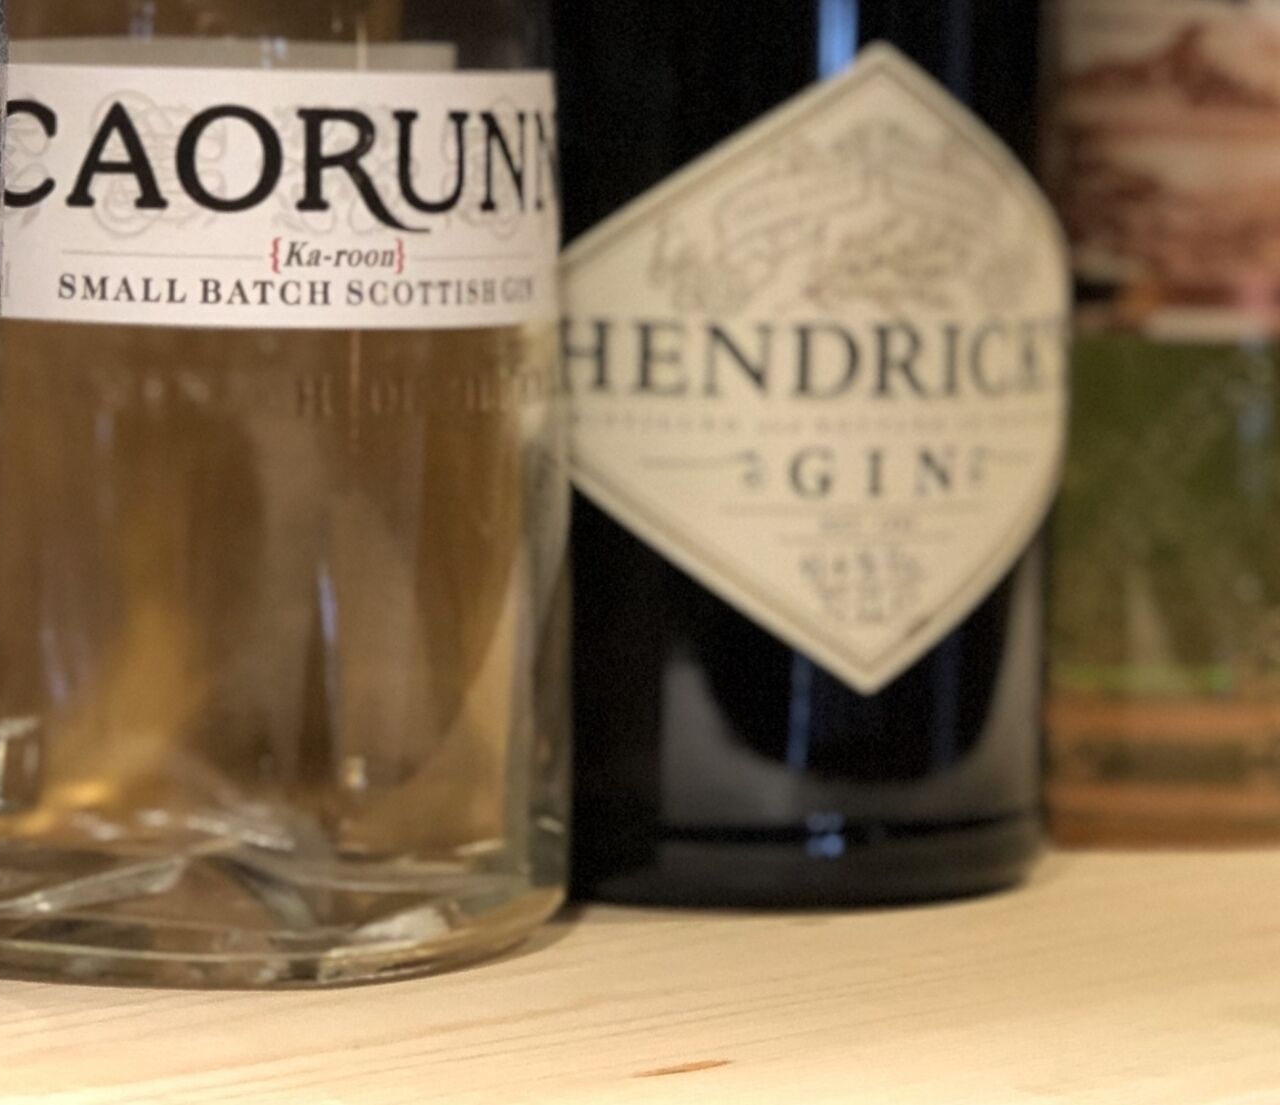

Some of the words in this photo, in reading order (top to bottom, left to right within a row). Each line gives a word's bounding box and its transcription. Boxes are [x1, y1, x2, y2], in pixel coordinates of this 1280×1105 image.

[58, 273, 186, 304] SMALL
[200, 278, 331, 307] BATCH
[346, 278, 496, 307] SCOTTISH
[789, 445, 954, 499] GIN
